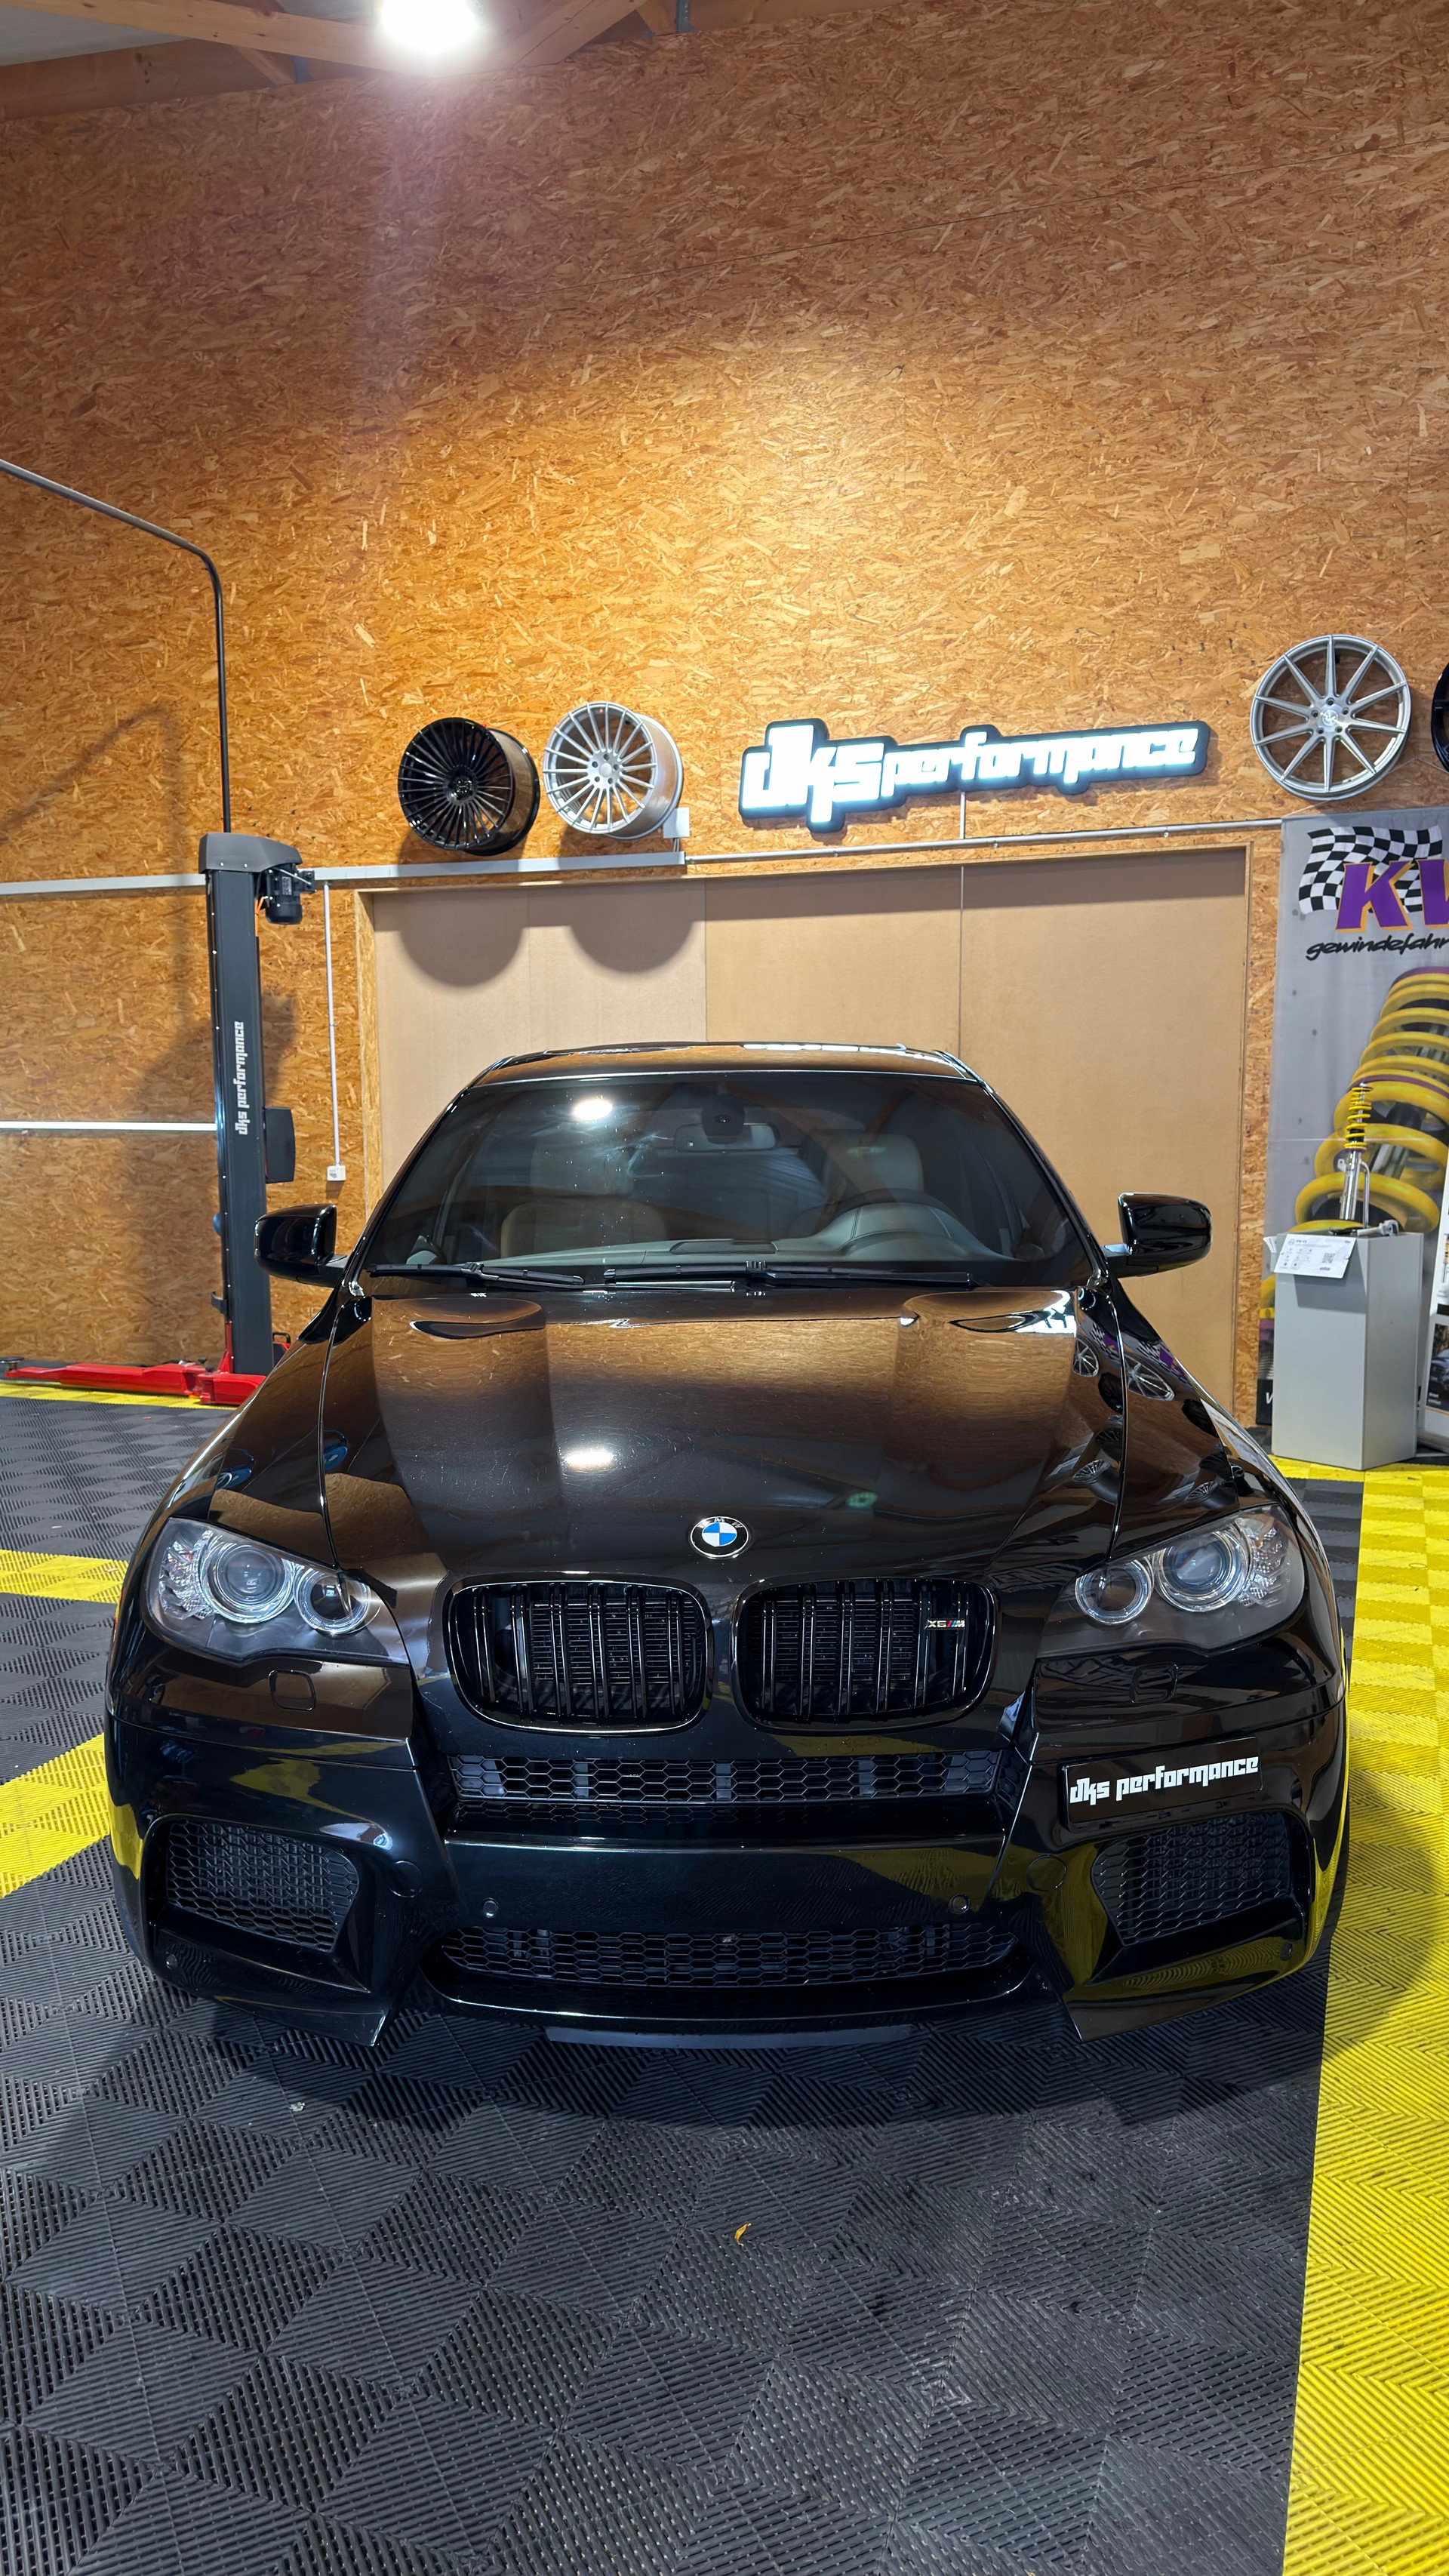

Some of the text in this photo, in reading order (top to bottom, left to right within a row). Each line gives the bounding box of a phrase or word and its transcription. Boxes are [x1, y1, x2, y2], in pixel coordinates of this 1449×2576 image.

[233, 1021, 250, 1109] performance
[697, 1516, 744, 1529] BMW
[1069, 1756, 1259, 1805] dks performance
